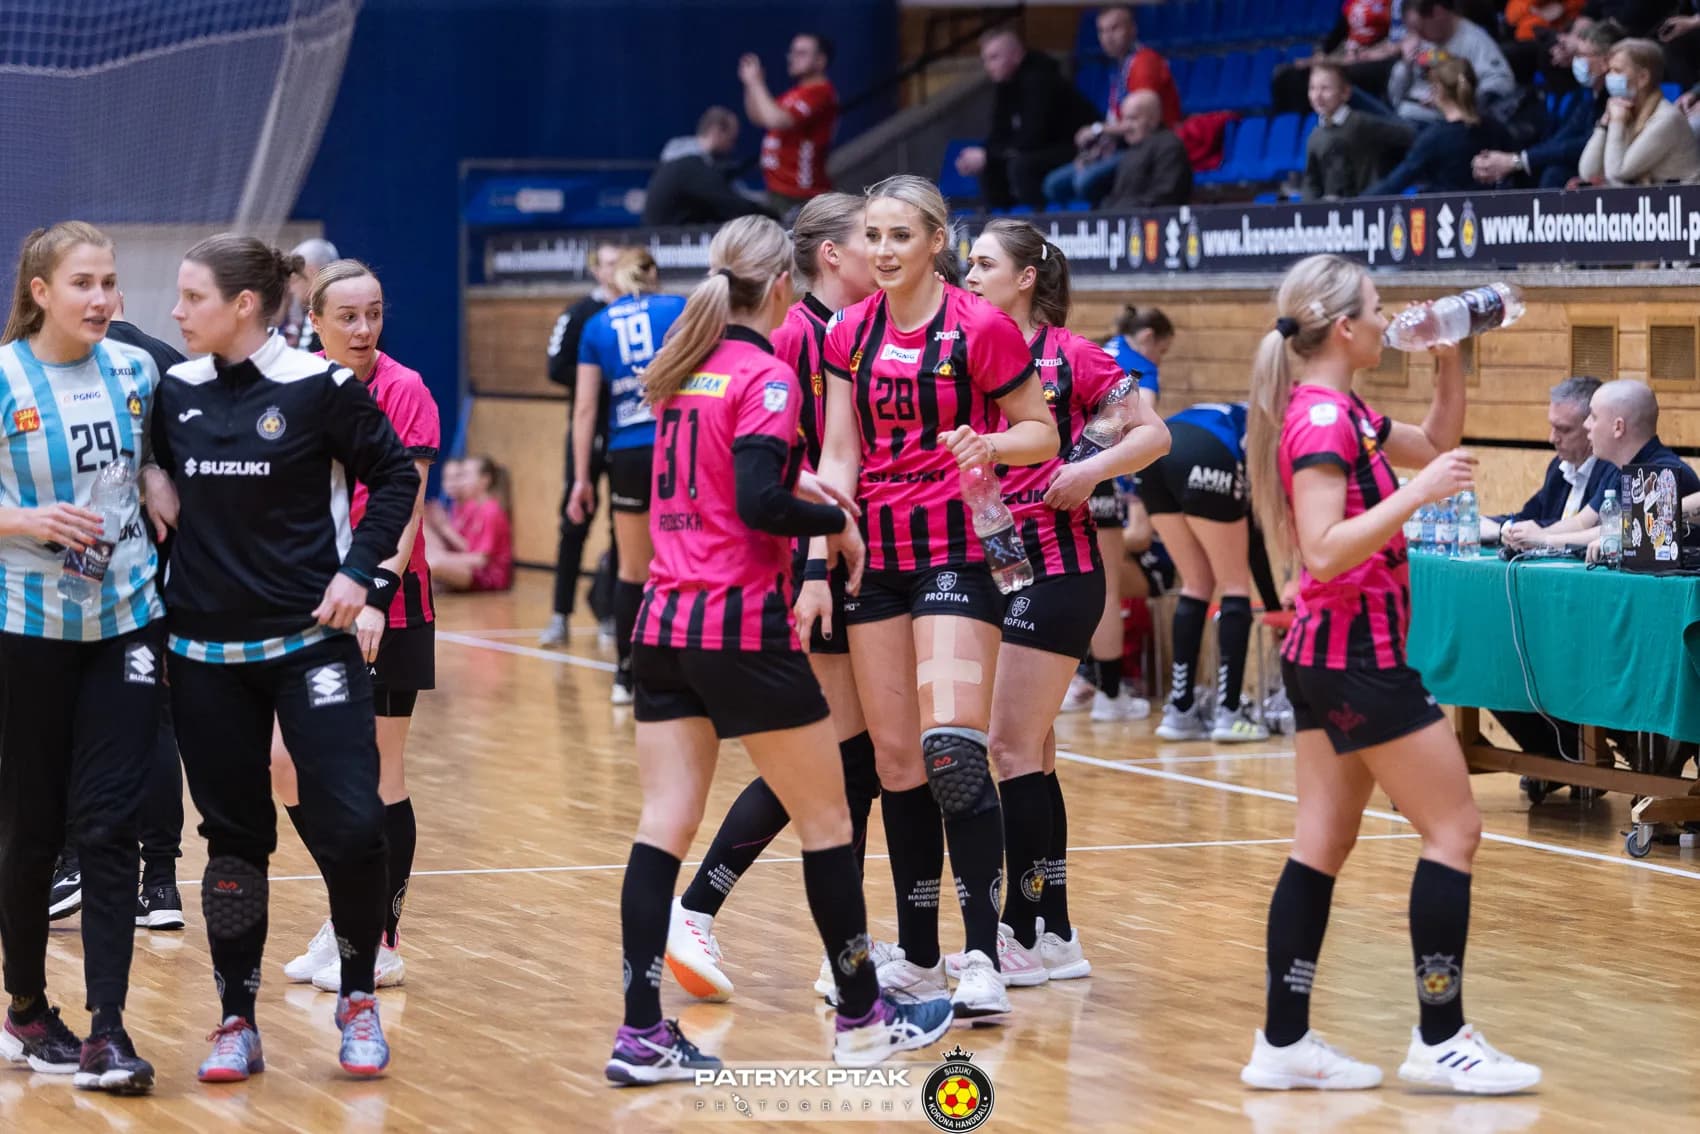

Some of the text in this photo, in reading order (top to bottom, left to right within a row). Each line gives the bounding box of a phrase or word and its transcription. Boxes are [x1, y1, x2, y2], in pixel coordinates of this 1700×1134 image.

[1203, 208, 1385, 264] www.koronahandball.pl
[611, 311, 654, 365] 19
[876, 377, 915, 420] 28
[70, 421, 118, 474] 29
[199, 460, 271, 475] SUZUKI
[658, 408, 699, 500] 31
[924, 592, 969, 603] PROFIKA
